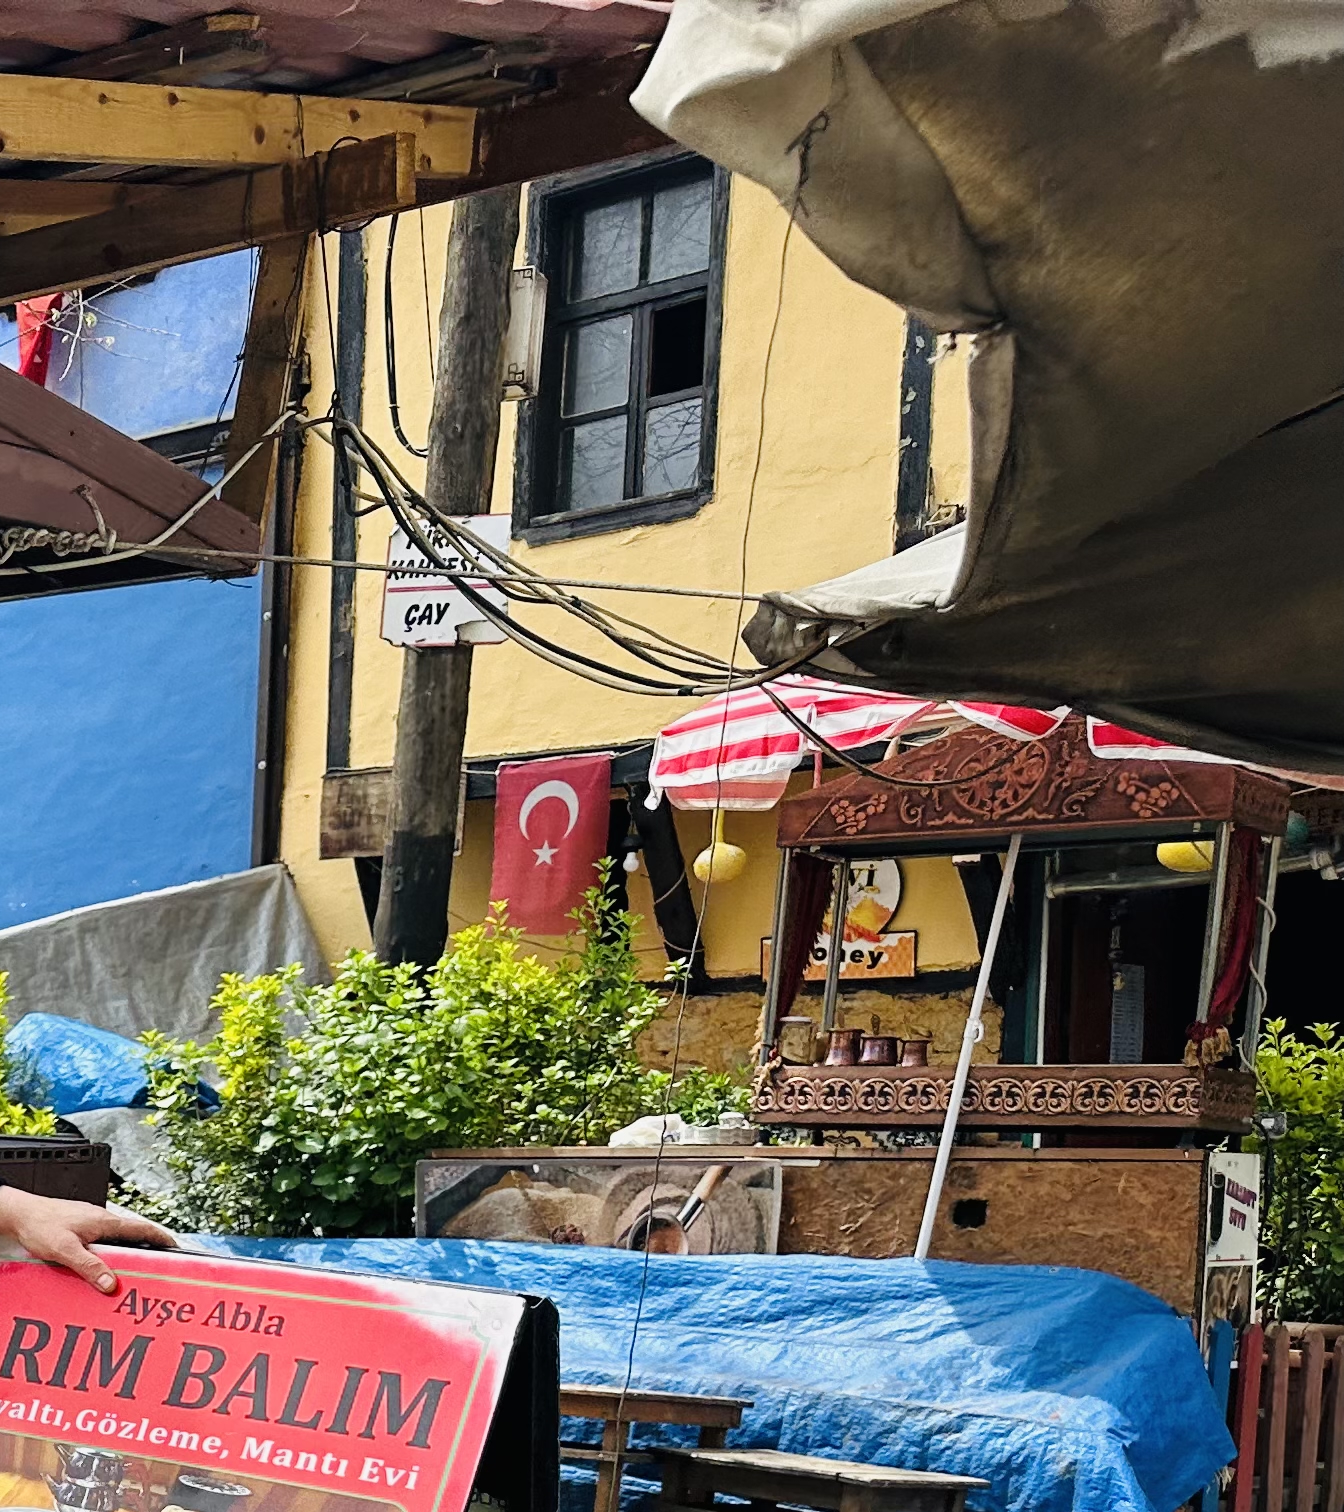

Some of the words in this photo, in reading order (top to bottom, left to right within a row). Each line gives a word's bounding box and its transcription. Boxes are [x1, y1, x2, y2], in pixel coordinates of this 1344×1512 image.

[404, 602, 450, 632] ÇAY
[111, 1286, 197, 1327] Ayşe
[202, 1299, 287, 1339] Abla
[162, 1341, 451, 1450] BALIM
[241, 1436, 348, 1479] Mantı
[357, 1456, 419, 1492] Evi
